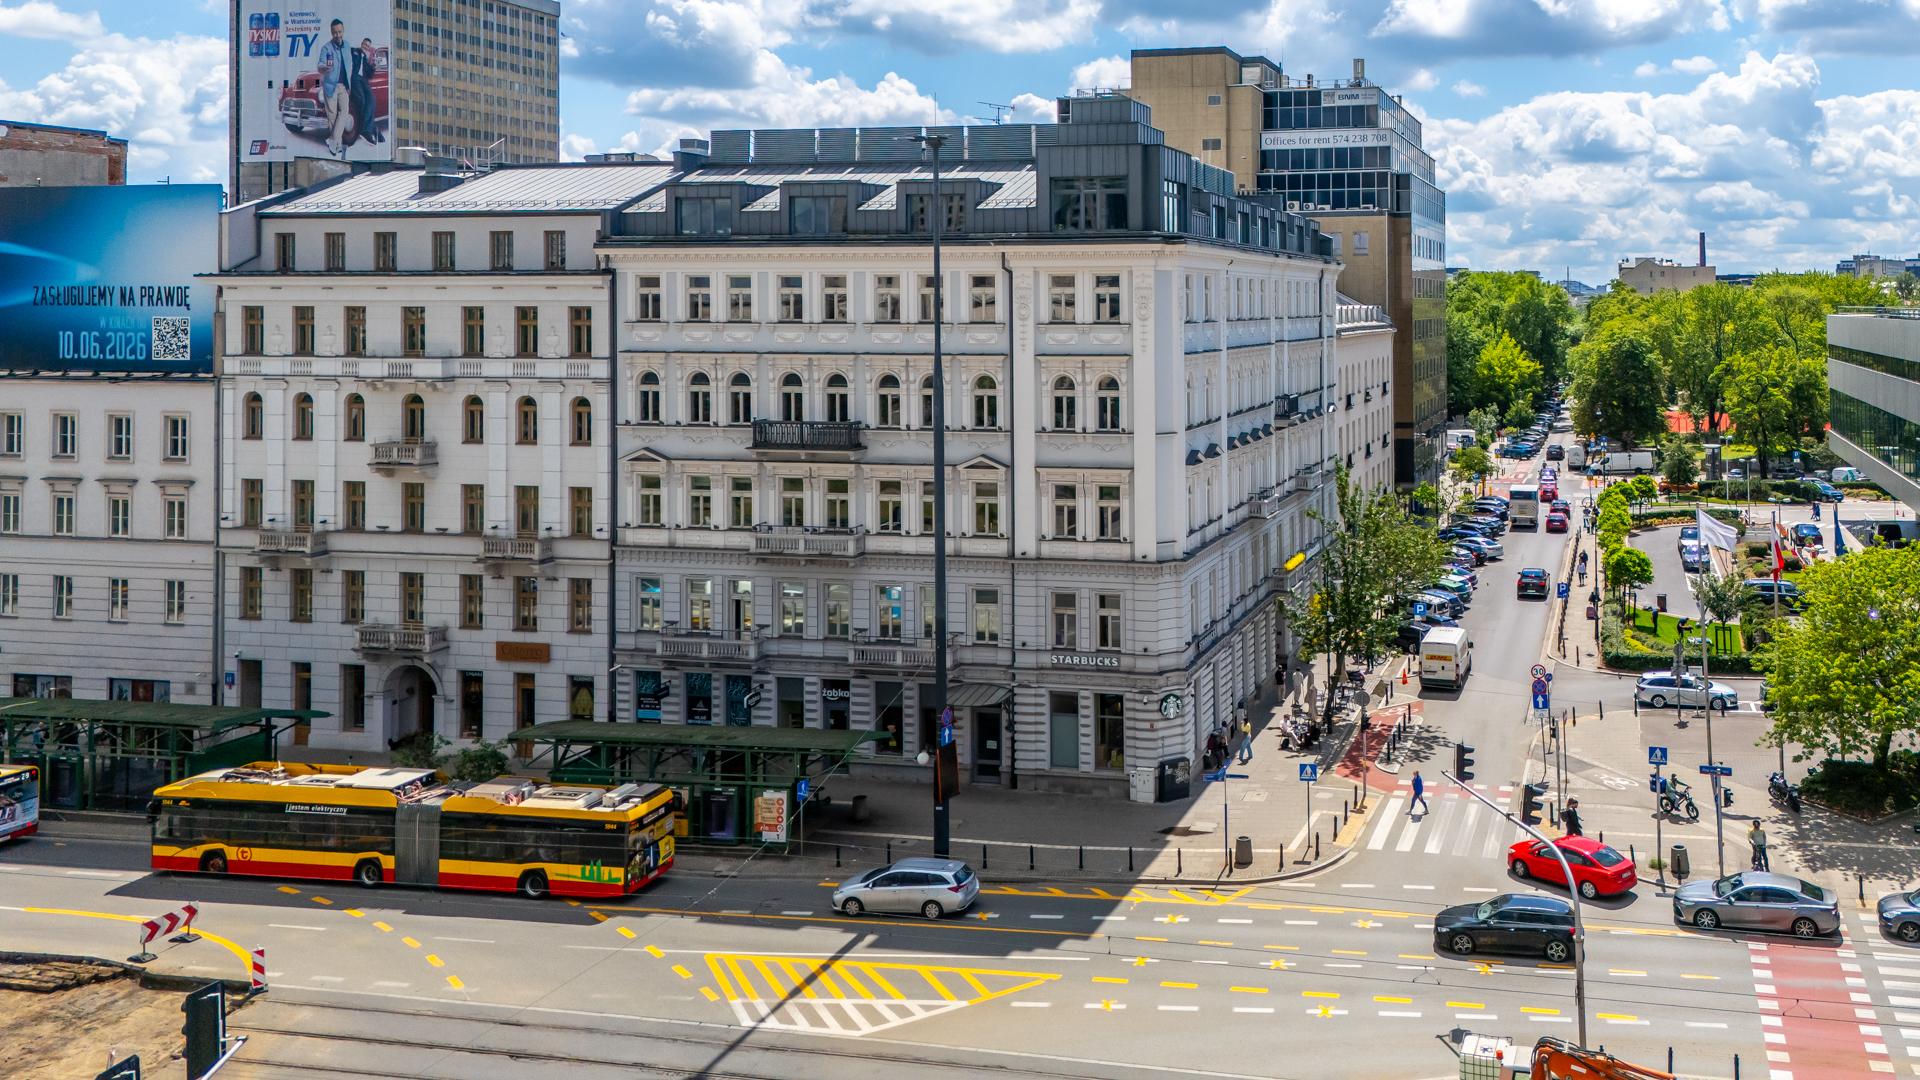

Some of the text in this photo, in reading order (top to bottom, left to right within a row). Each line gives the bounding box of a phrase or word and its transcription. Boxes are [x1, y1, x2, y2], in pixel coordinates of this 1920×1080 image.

[286, 33, 319, 58] TY
[1337, 93, 1360, 101] BNM
[1264, 133, 1388, 146] Offices for rent 574 238 708
[33, 285, 191, 310] ZASŁUGUJEMY NA PRAWDĘ
[58, 331, 146, 360] 10.06.2026
[1560, 584, 1567, 592] P
[1416, 604, 1424, 613] P
[1051, 655, 1119, 667] STARBUCKS
[1533, 667, 1544, 676] 30
[822, 687, 850, 698] żabka
[311, 805, 348, 815] elektryczny
